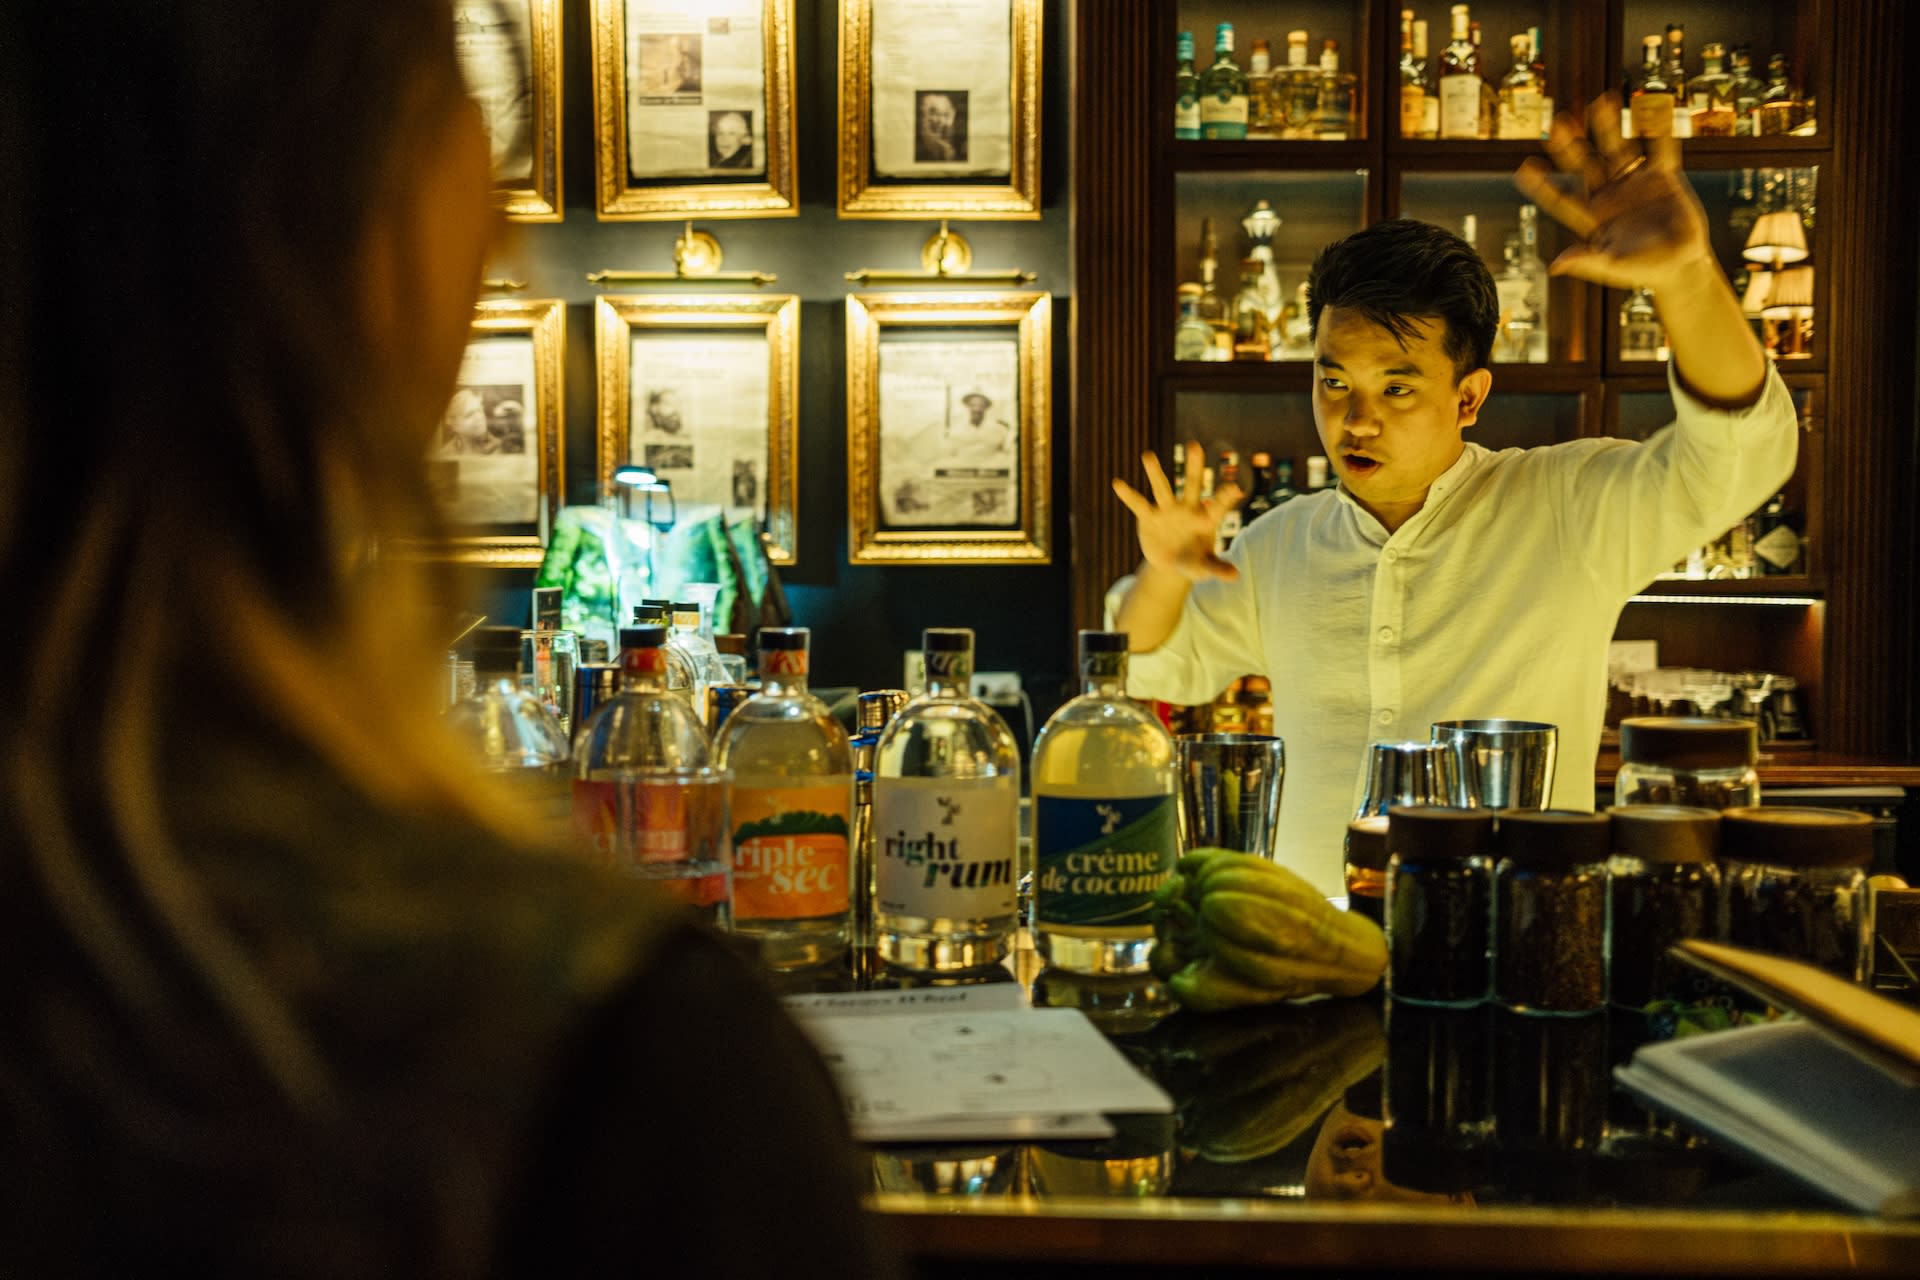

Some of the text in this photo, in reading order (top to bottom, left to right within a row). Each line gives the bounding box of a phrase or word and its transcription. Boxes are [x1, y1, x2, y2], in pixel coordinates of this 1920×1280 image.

[734, 838, 815, 876] riple
[885, 830, 958, 866] right
[768, 864, 840, 894] sec
[923, 858, 1011, 888] rum
[1041, 866, 1068, 892] de
